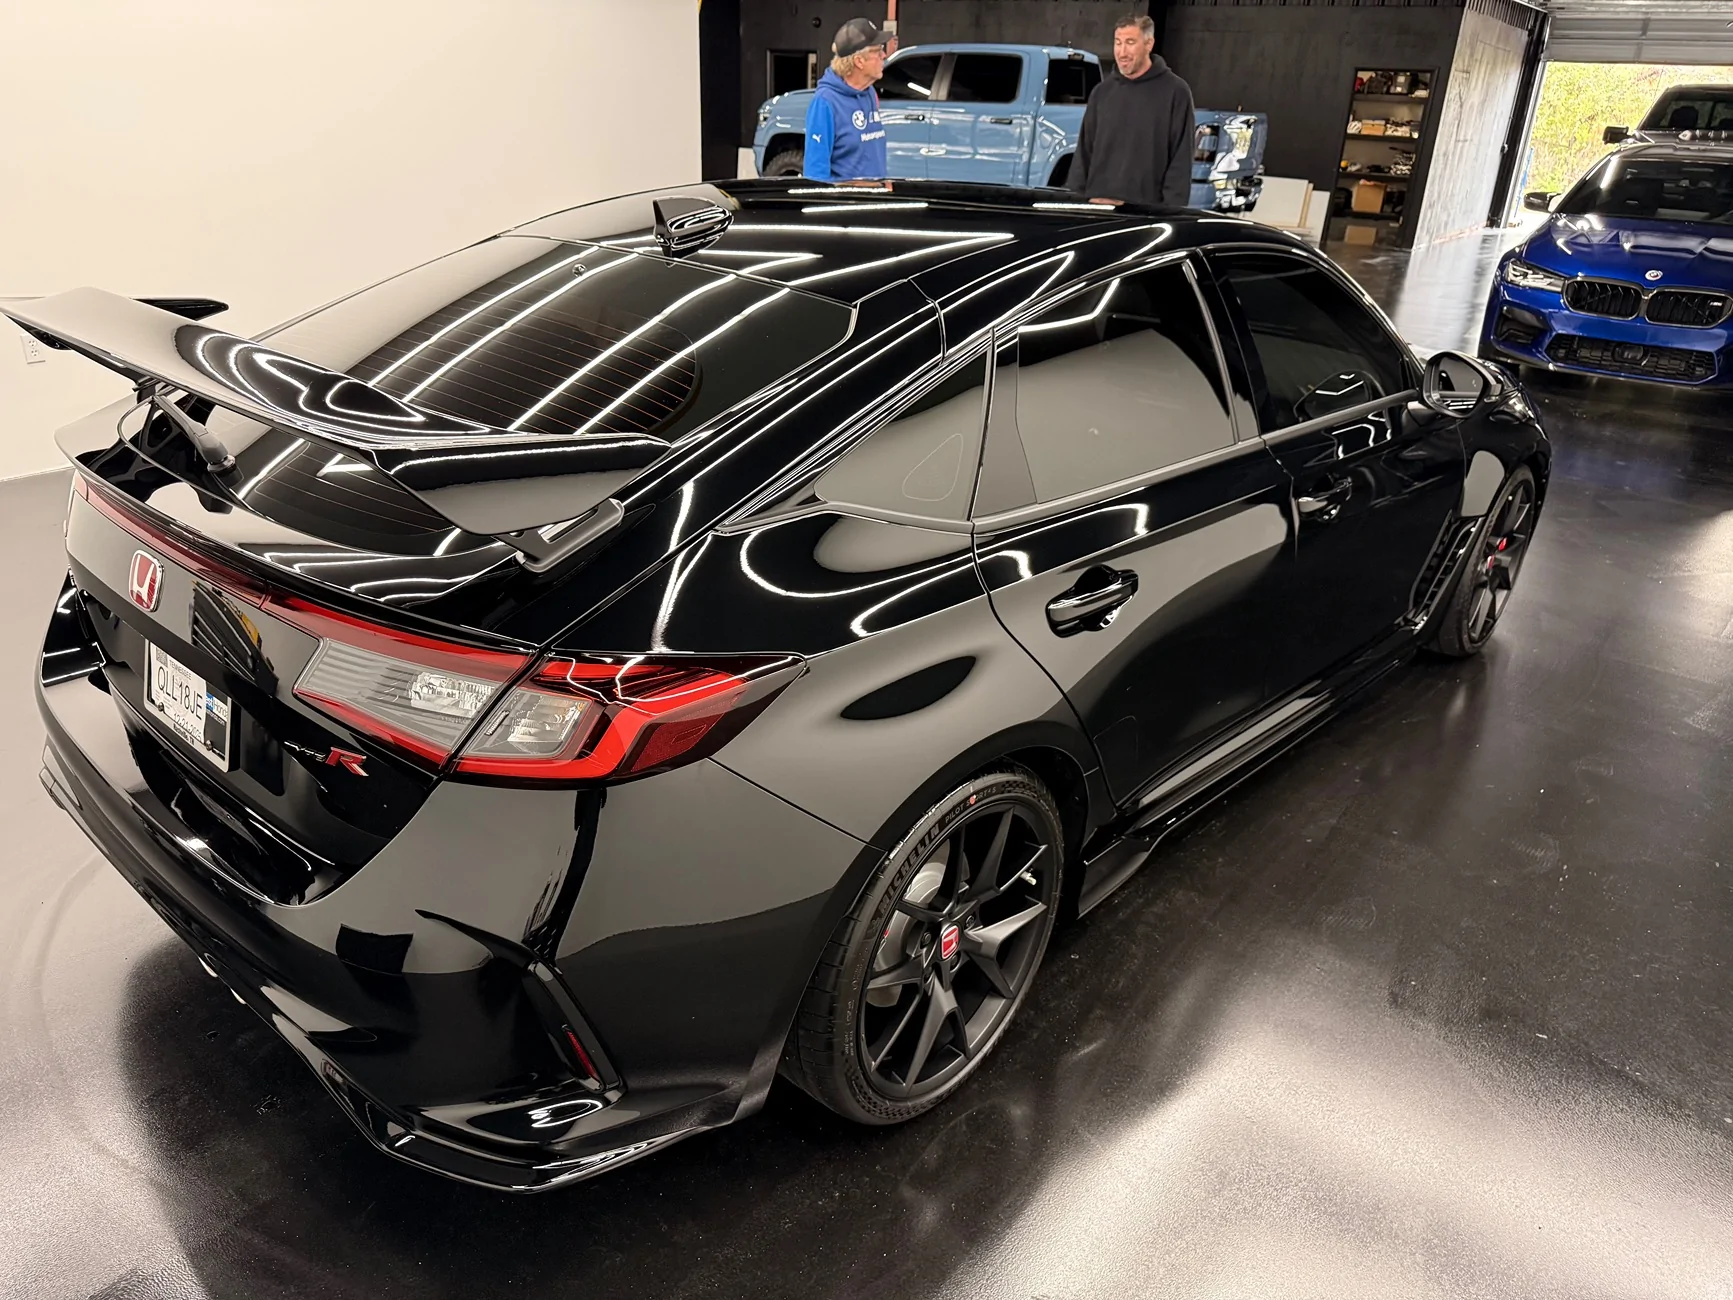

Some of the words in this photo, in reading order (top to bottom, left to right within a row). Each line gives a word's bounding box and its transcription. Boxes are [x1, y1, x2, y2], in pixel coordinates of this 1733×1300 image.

[157, 666, 203, 720] QLL18JE
[325, 746, 369, 777] R
[945, 804, 965, 824] PILOT
[966, 791, 988, 806] SORT
[879, 823, 940, 914] MICHELIN
